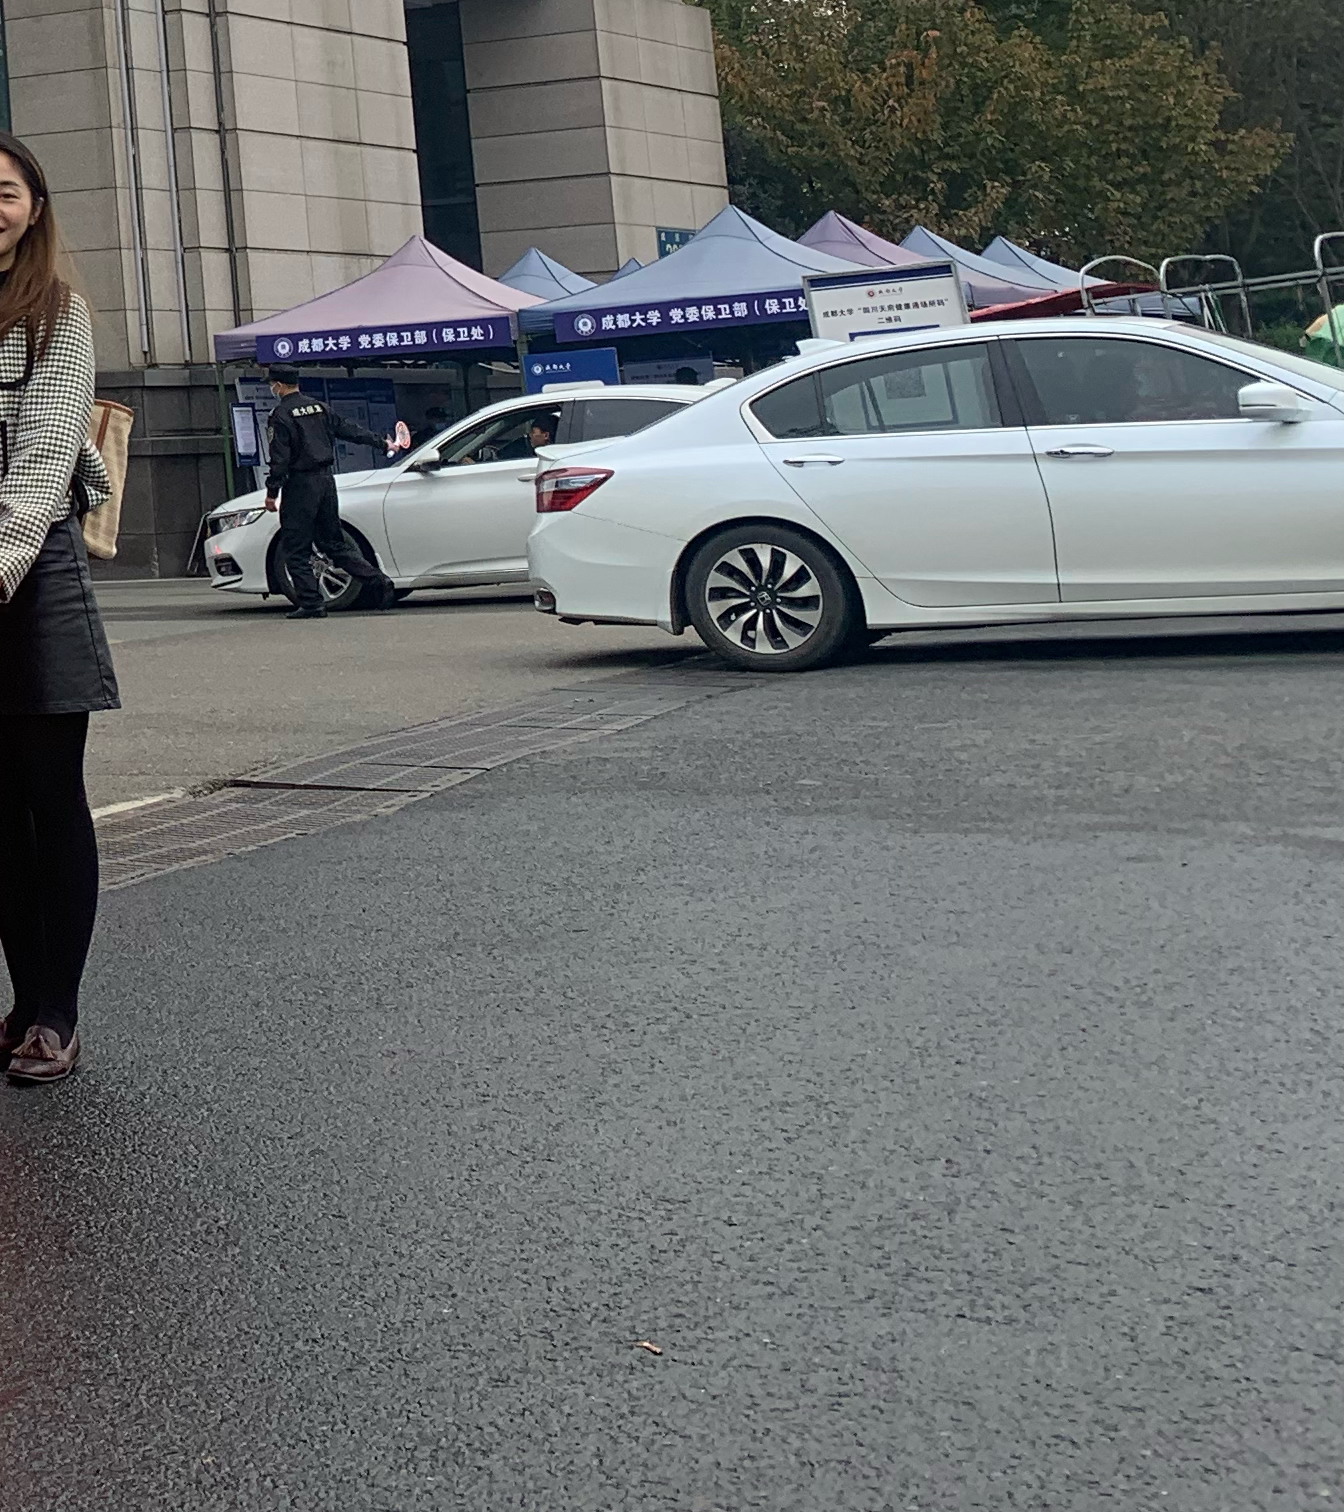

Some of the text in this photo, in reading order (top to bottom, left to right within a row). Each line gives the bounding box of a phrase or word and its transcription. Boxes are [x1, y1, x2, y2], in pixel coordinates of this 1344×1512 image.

[601, 310, 662, 331] 成都大学
[297, 324, 494, 354] 成都大学 党委保卫部（保卫处）
